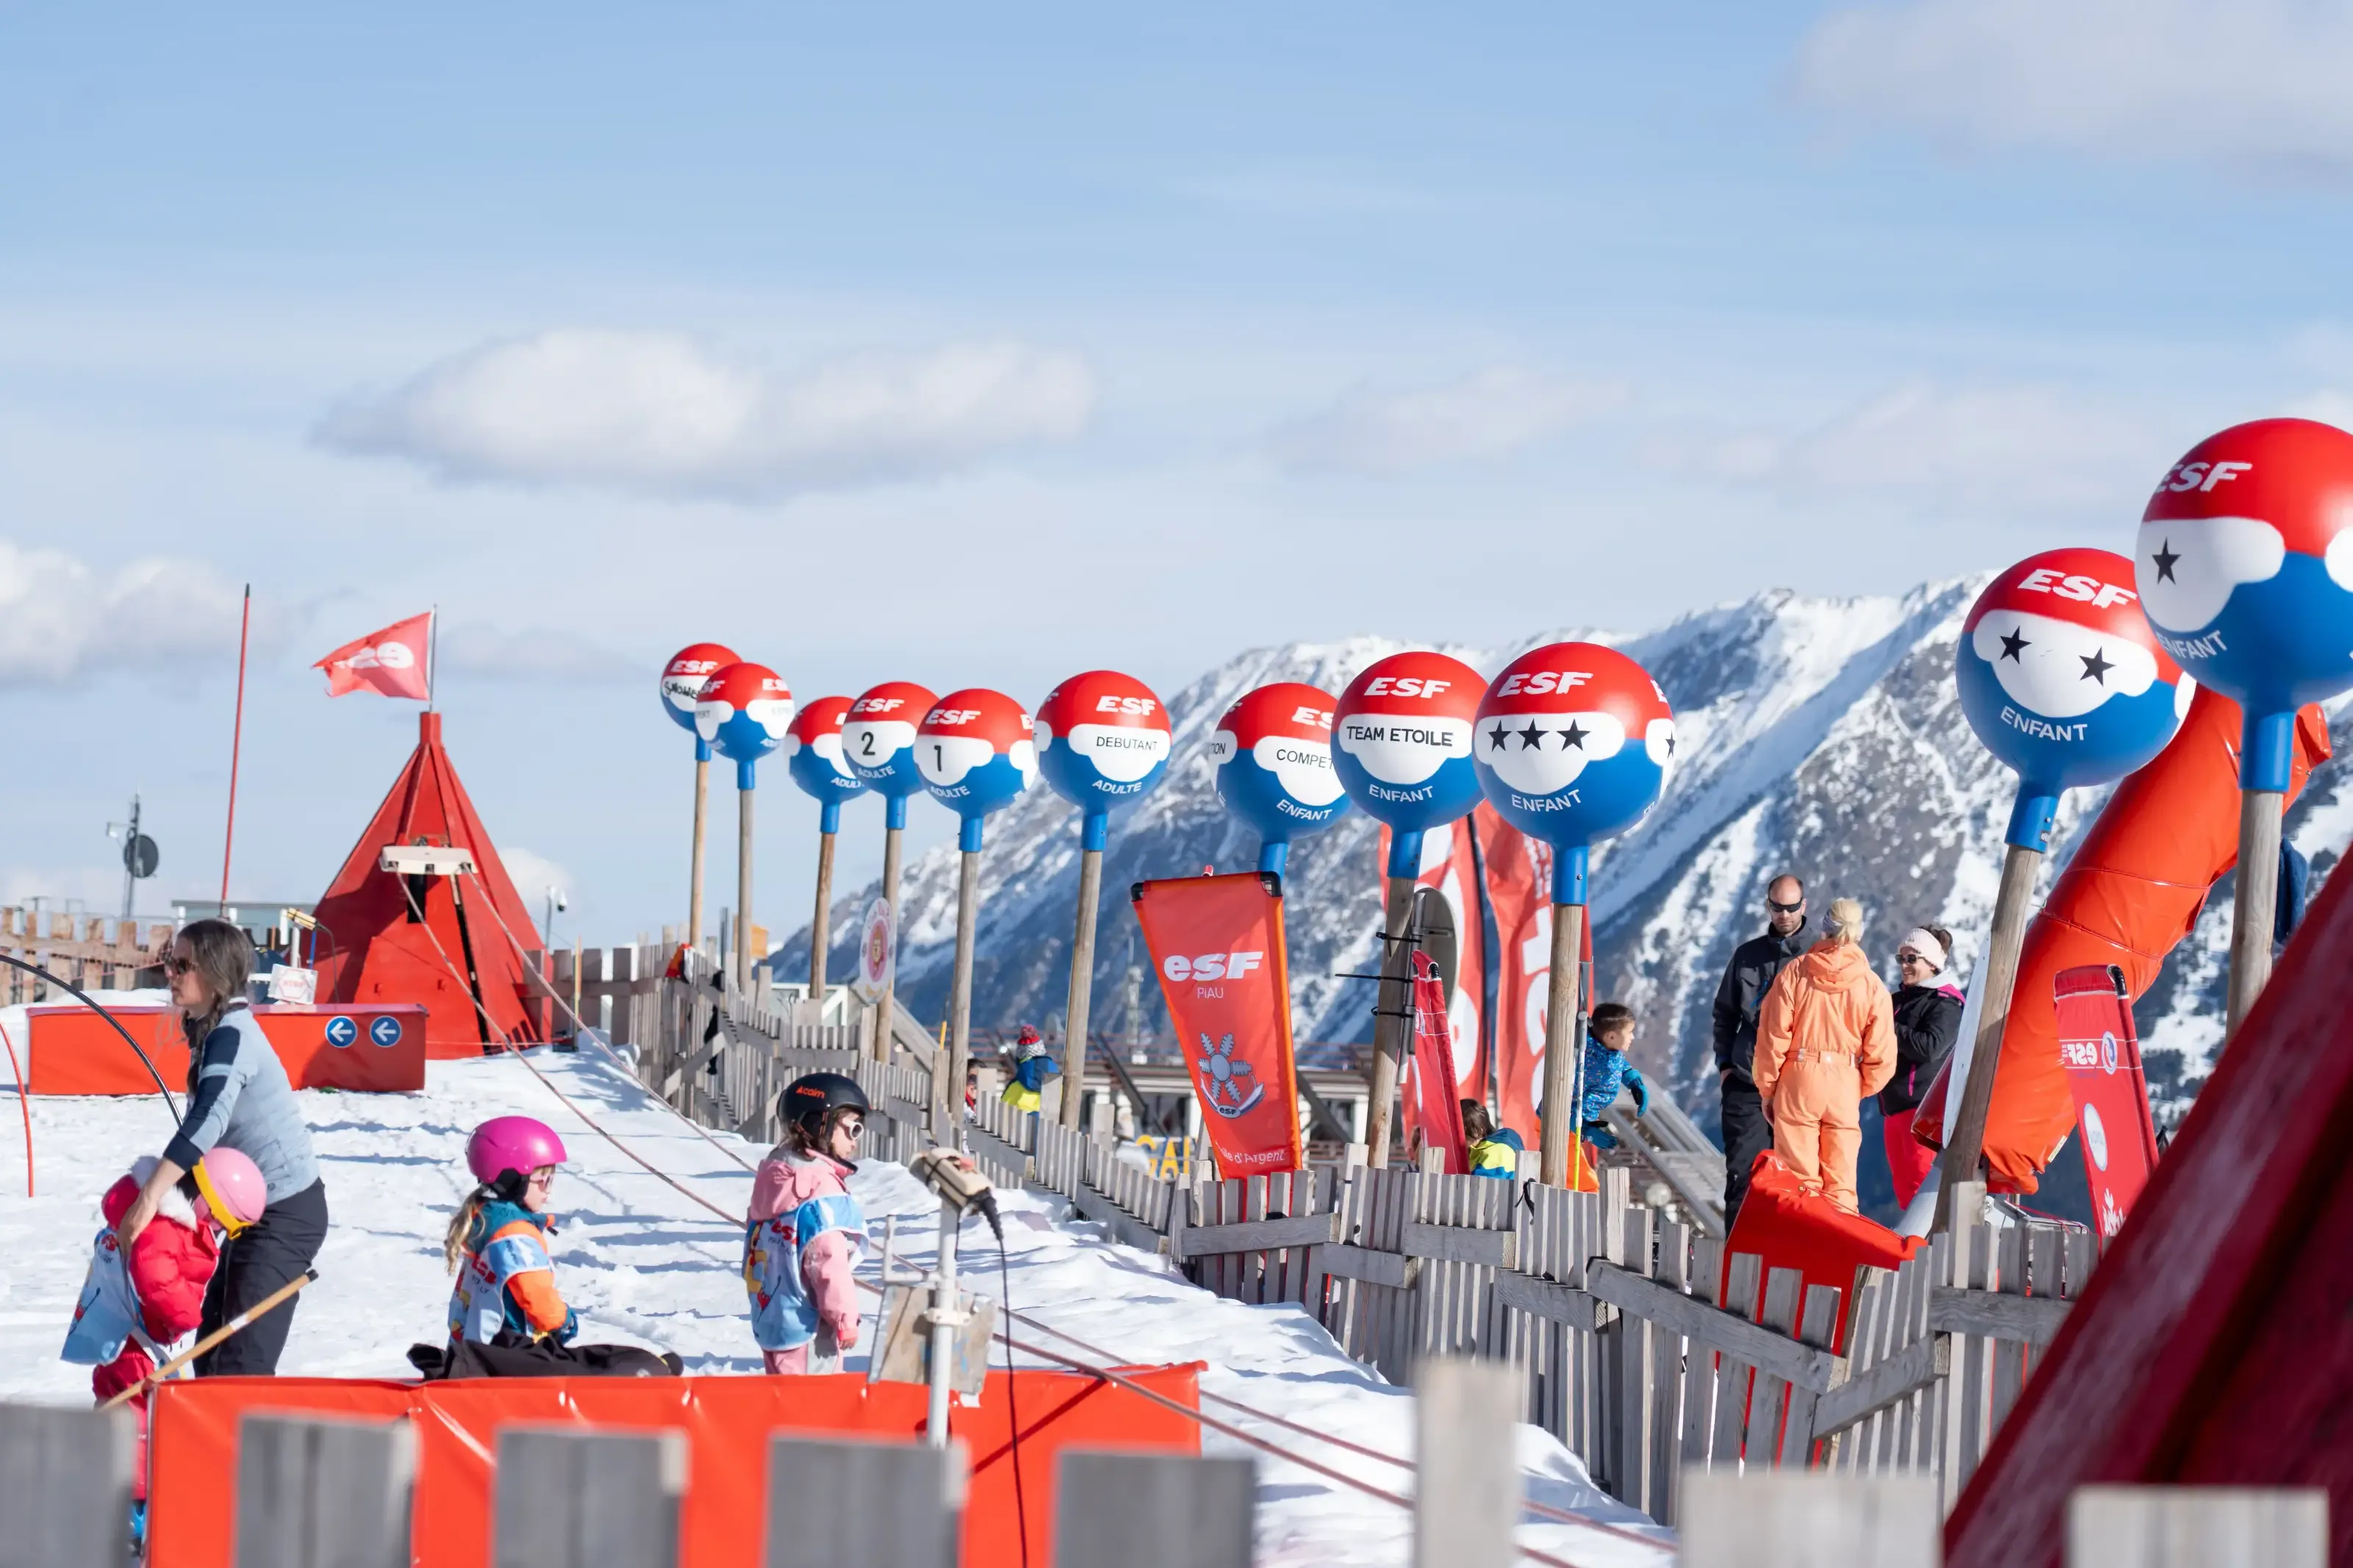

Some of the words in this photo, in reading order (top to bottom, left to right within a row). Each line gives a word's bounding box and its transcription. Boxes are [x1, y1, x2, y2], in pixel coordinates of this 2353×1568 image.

[2017, 568, 2138, 609] ESF
[671, 660, 718, 674] ESF
[1364, 677, 1451, 698] ESF
[1497, 671, 1593, 697] ESF
[852, 698, 904, 712] ESF
[1096, 695, 1156, 716] ESF
[925, 709, 981, 725] ESF
[1999, 705, 2088, 741] ENFANT
[860, 731, 876, 756] 2
[1096, 736, 1157, 751] DEBUTANT
[1346, 726, 1385, 741] TEAM
[1390, 728, 1454, 747] ETOILE
[934, 745, 942, 772] 1
[857, 765, 896, 779] ADULTE
[929, 784, 971, 798] ADULTE
[1092, 779, 1142, 795] ADULTE
[1368, 784, 1434, 802] ENFANT
[1276, 799, 1333, 821] ENFANT
[1511, 789, 1582, 812] ENFANT
[1235, 1150, 1285, 1164] d'Argent
